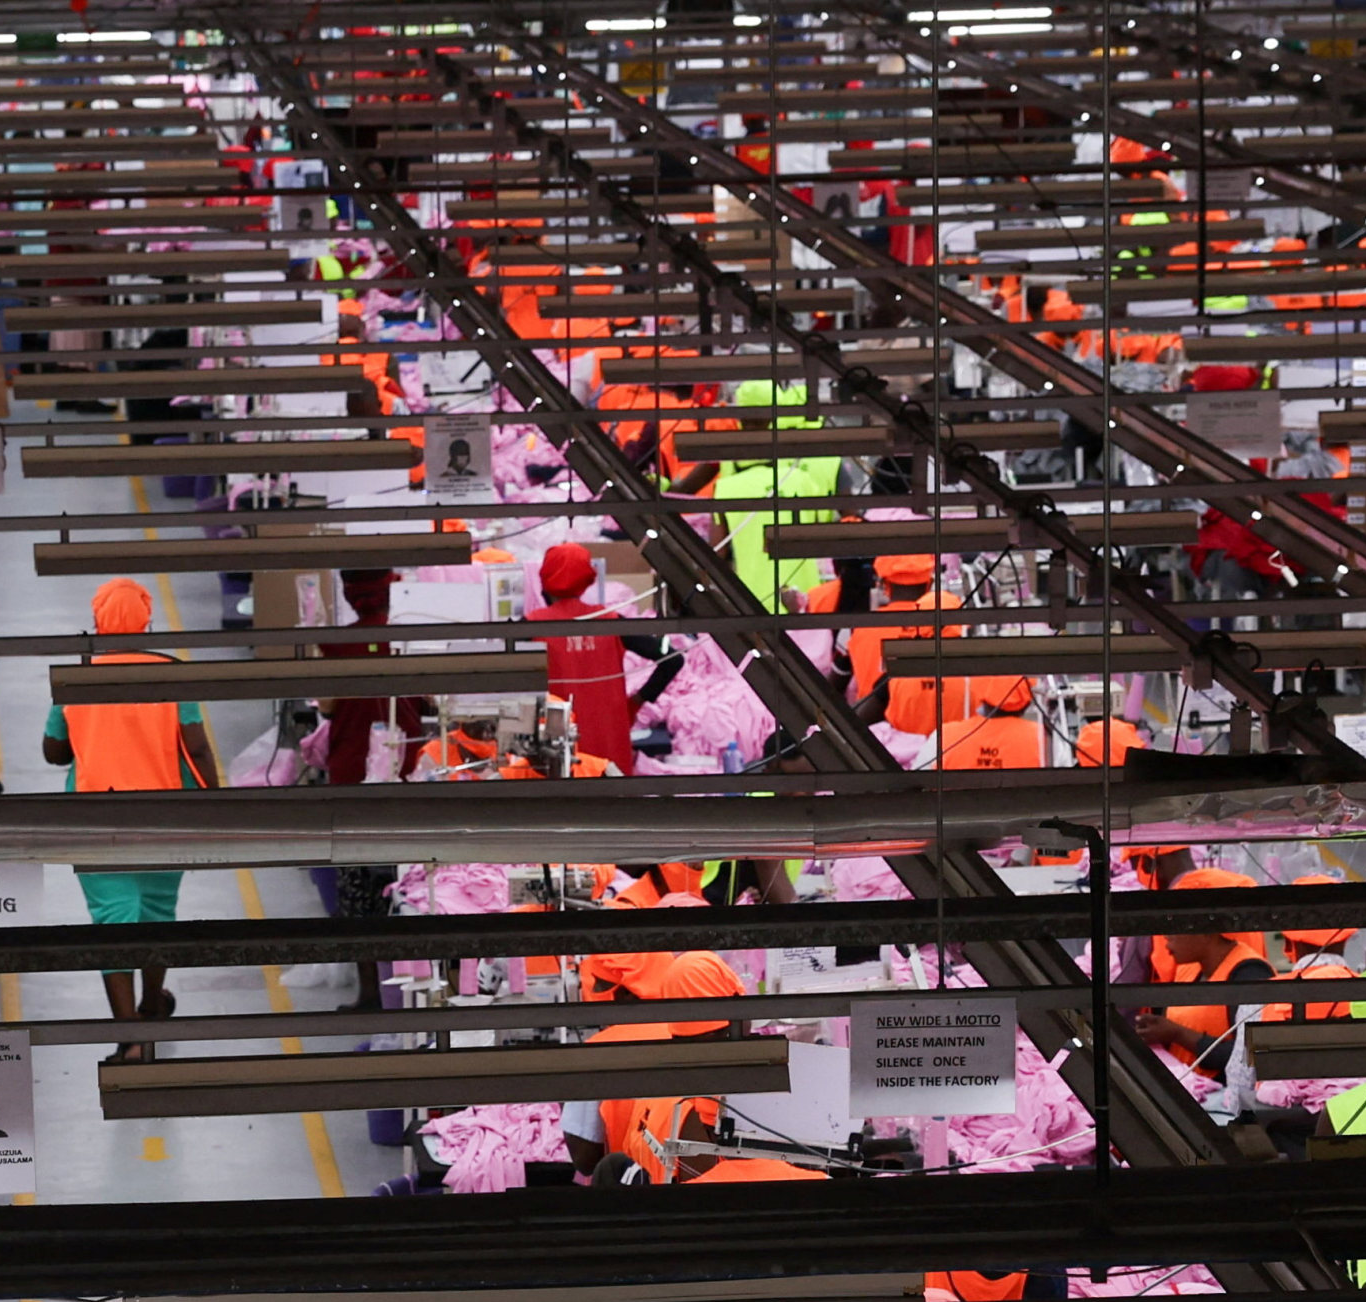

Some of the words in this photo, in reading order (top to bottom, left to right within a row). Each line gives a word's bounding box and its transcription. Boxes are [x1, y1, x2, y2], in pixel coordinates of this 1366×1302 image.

[876, 1016, 905, 1027] NEW
[908, 1015, 941, 1026] WIDE
[945, 1015, 952, 1025] 1
[956, 1014, 1001, 1025] MOTTO
[876, 1037, 919, 1048] PLEASE
[922, 1036, 985, 1047] MAINTAIN
[876, 1057, 923, 1068] SILENCE
[933, 1056, 966, 1067] ONCE
[876, 1077, 915, 1087] INSIDE
[918, 1076, 942, 1087] THE
[945, 1075, 999, 1086] FACTORY
